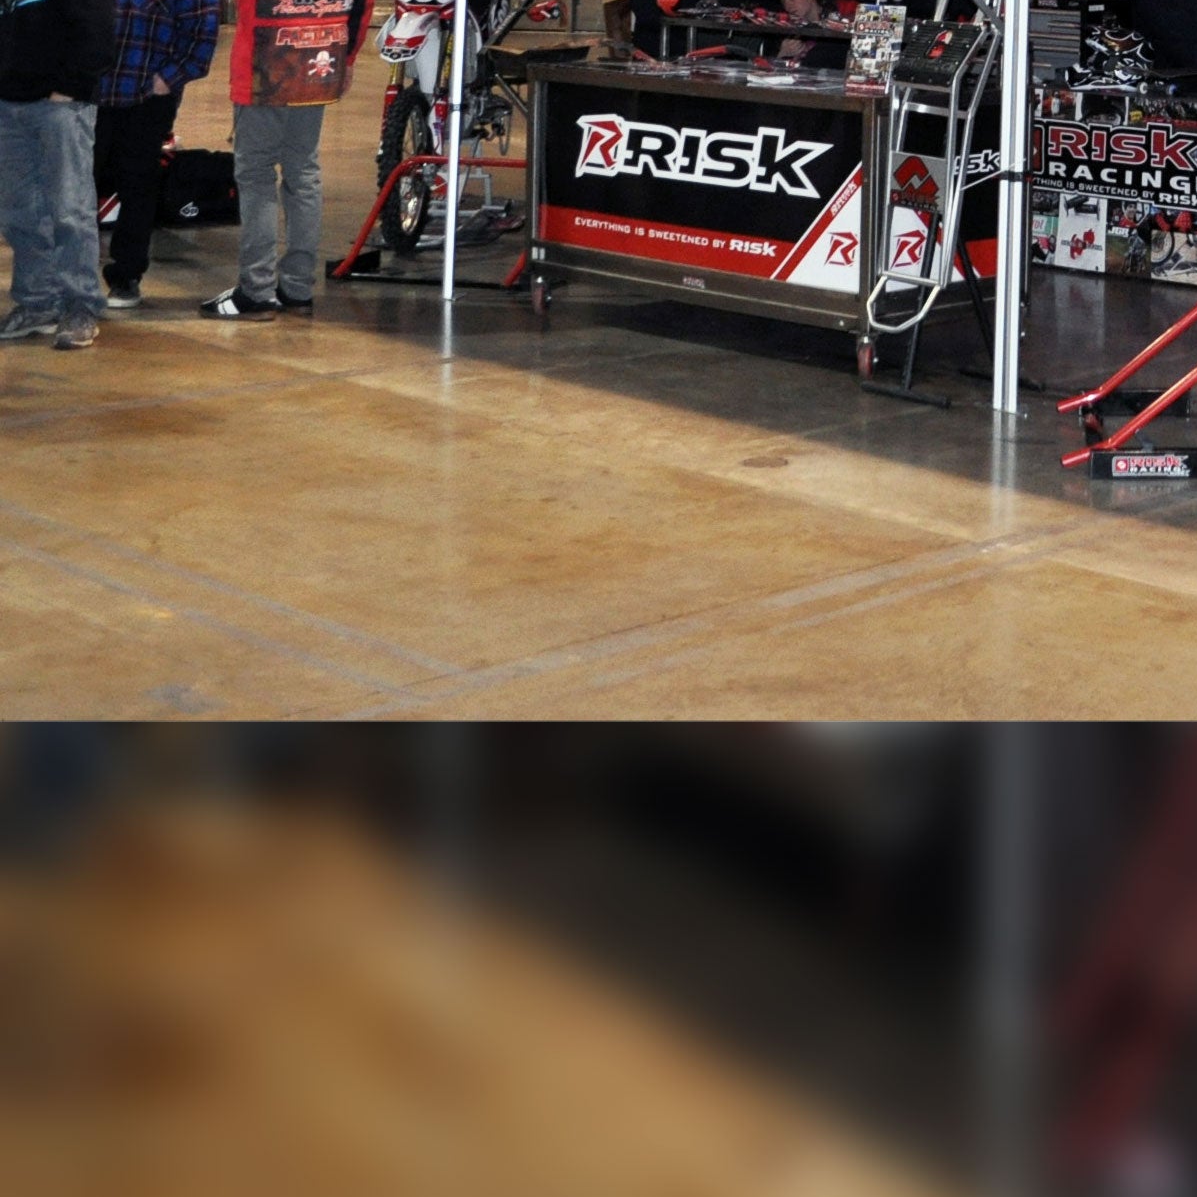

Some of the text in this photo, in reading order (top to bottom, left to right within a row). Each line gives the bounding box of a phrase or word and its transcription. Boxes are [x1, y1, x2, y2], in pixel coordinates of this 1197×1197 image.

[618, 121, 834, 200] RISK
[1047, 126, 1195, 172] RISK
[1049, 161, 1191, 195] RACING
[1078, 183, 1138, 198] SWEETENED
[1142, 190, 1155, 200] BY
[574, 216, 778, 257] EVERYTHING IS SWEETENED BY RISK
